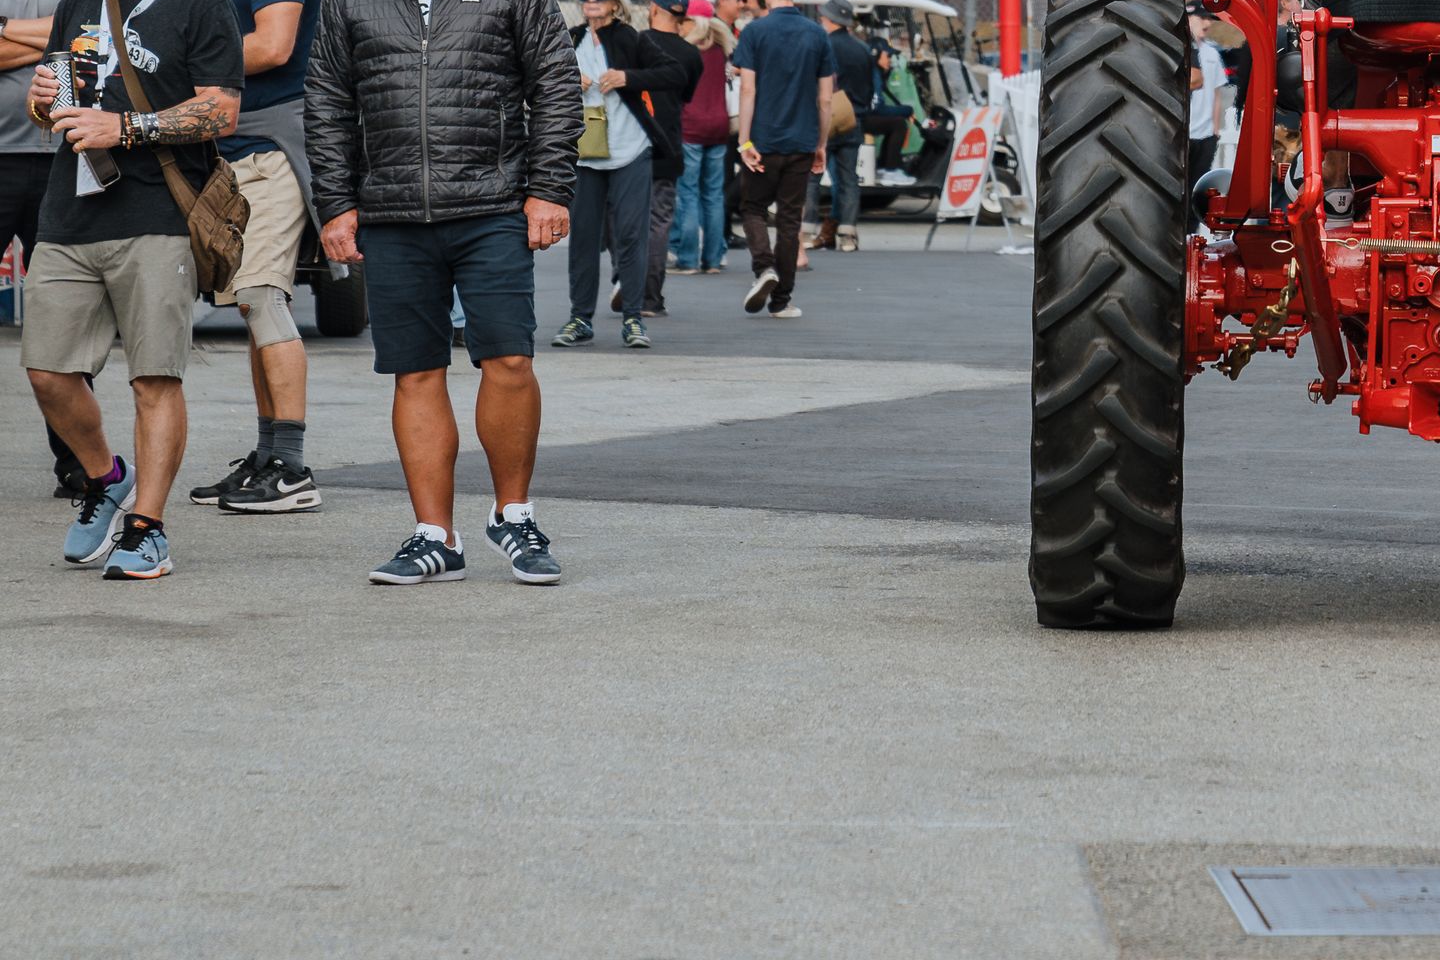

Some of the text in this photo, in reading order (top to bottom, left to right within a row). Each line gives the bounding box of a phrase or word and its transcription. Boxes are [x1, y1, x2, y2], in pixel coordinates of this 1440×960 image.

[128, 47, 141, 61] 43
[958, 142, 986, 157] DO NOT
[951, 178, 975, 193] ENTER
